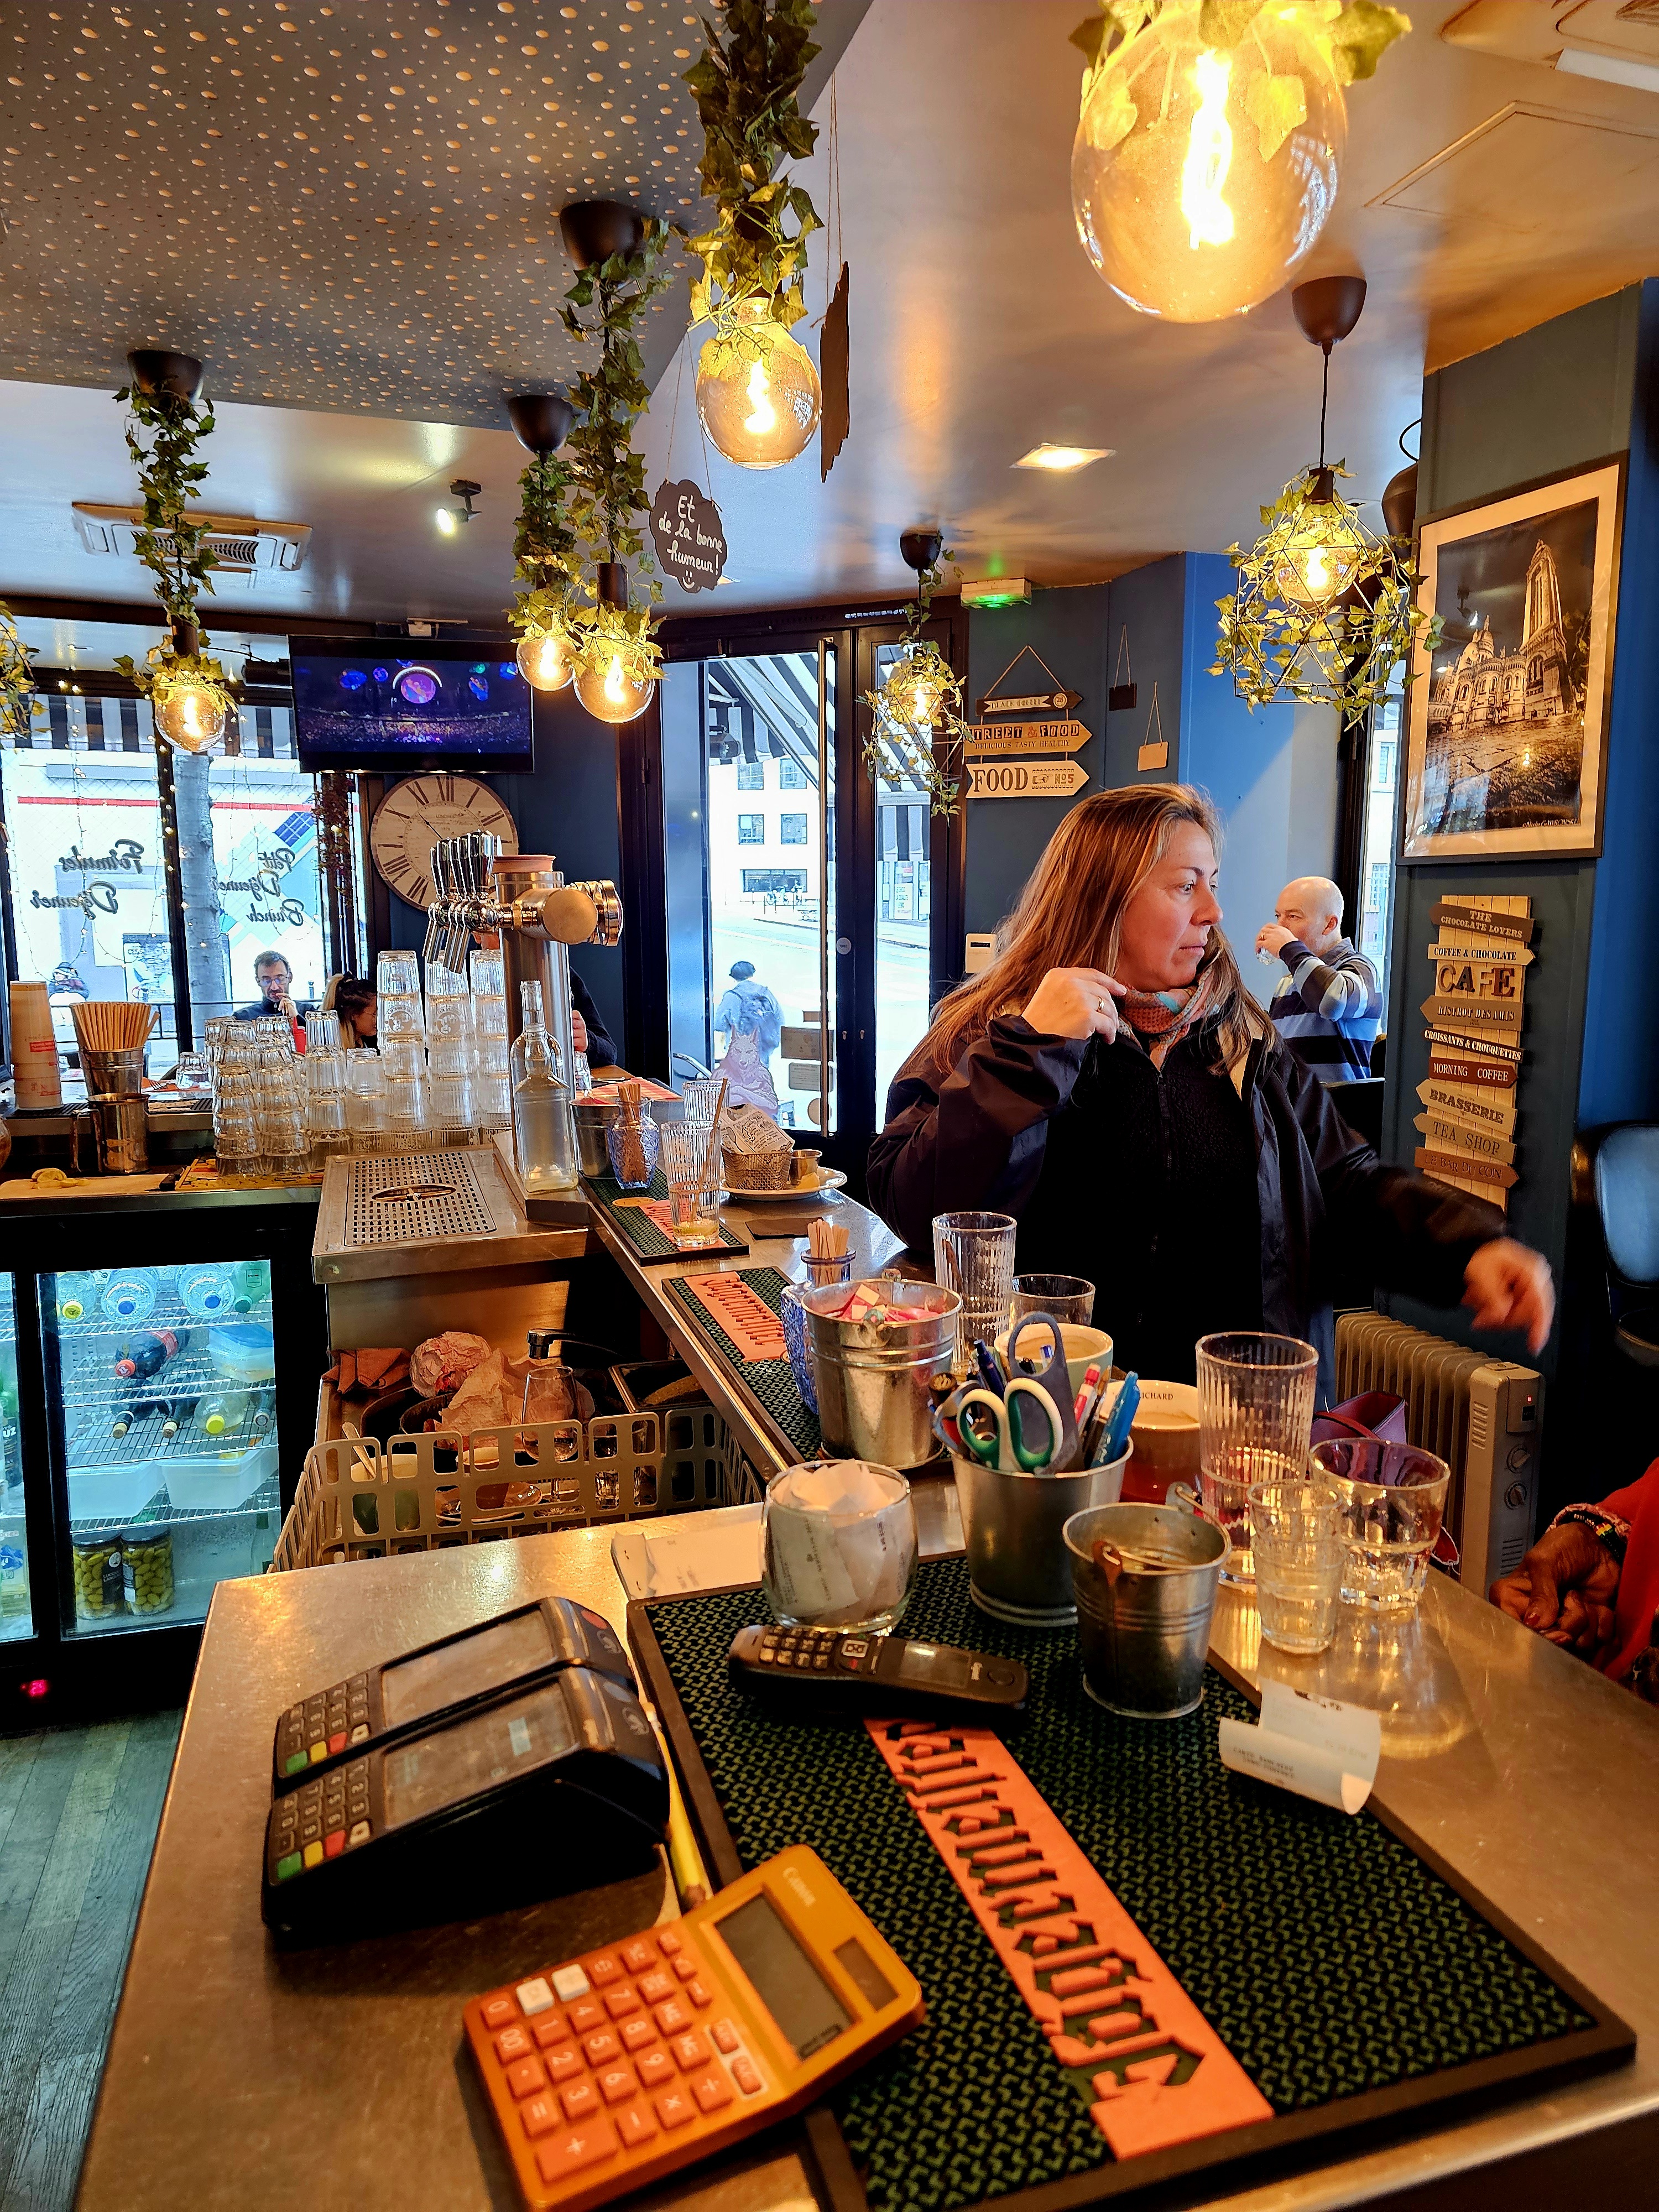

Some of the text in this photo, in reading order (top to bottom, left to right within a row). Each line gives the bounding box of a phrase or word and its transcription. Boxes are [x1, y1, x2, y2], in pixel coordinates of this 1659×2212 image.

[677, 494, 695, 523] Et
[659, 511, 723, 554] de la bonne
[971, 724, 1080, 740] TREET & FOOD
[973, 767, 1028, 792] FOOD
[1441, 916, 1523, 938] CHOCOLATE LOVERS
[1470, 911, 1492, 923] THE
[1434, 947, 1517, 961] COFFEE & CHOCOLATE
[1438, 964, 1516, 997] CAFE
[1437, 1005, 1473, 1019] BISTROT
[1475, 1009, 1491, 1020] DES
[1424, 1030, 1522, 1061] CROISSANTS & CHOUQUETTES
[1433, 1062, 1509, 1082] MORNING COFFEE
[1429, 1088, 1504, 1124] BRASSERIE
[1433, 1121, 1500, 1155] TEA SHOP
[1425, 1154, 1503, 1180] LE BAR DU COIN
[1140, 1391, 1173, 1401] ICHARD
[488, 2000, 525, 2050] 0 00
[609, 1988, 665, 2068] 7 8 9
[539, 2018, 591, 2101] 1 2 3
[577, 2006, 629, 2087] 4 5 6
